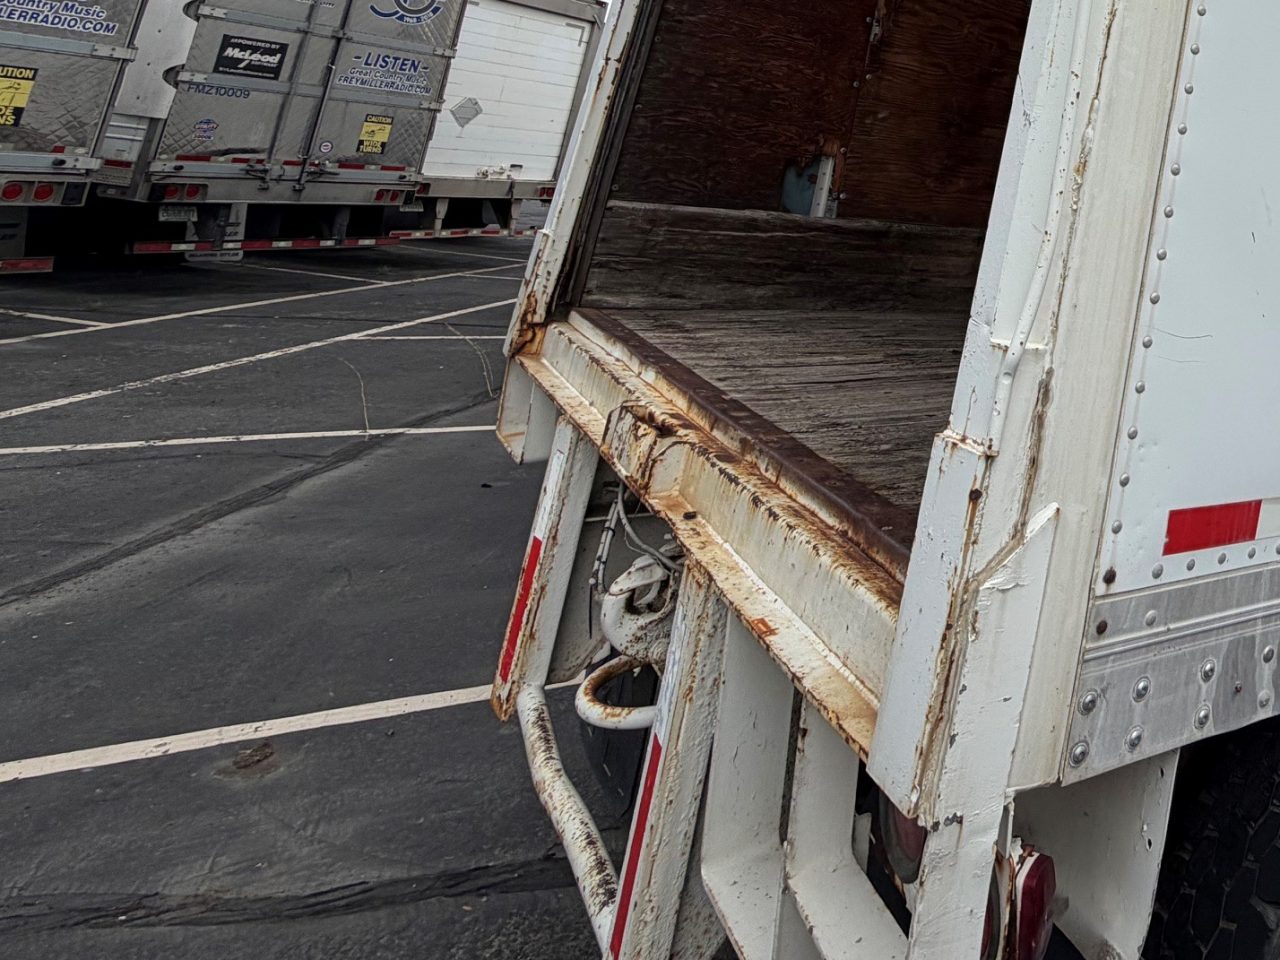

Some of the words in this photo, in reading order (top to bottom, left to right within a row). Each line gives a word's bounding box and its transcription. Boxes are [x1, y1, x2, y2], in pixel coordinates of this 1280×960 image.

[60, 2, 106, 19] Music
[223, 47, 282, 68] McLeod
[338, 75, 432, 94] FREYMILLERRADIO.COM
[349, 67, 372, 78] Great
[374, 71, 404, 82] Country
[406, 74, 427, 85] Music
[187, 83, 251, 99] FMZ10009
[367, 115, 393, 123] CAUTION
[360, 145, 383, 153] TURNS
